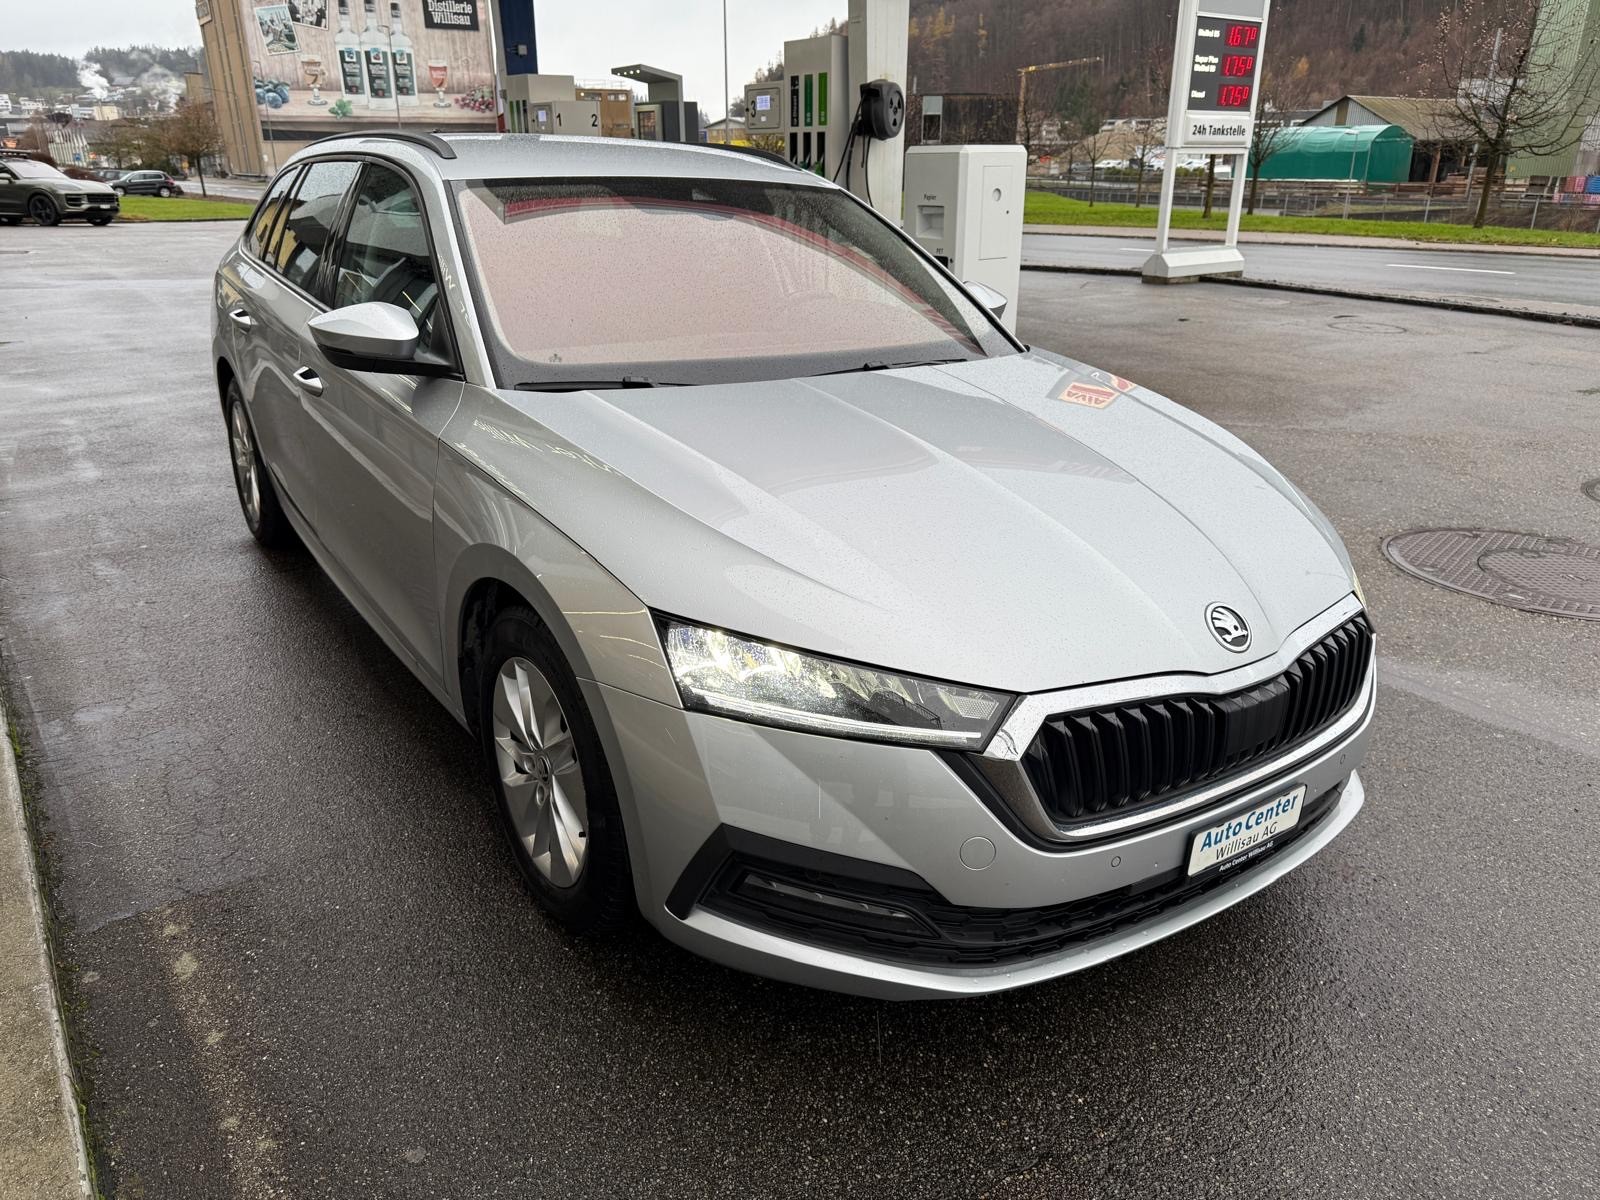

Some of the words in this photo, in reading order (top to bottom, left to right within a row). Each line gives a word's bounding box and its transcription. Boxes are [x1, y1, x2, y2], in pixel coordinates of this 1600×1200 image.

[427, 0, 473, 14] Distillerie
[431, 11, 471, 25] Willisau
[750, 100, 757, 118] 3
[556, 112, 563, 127] 1
[591, 113, 598, 127] 2
[1192, 124, 1206, 136] 24h
[1208, 124, 1246, 136] Tankstelle
[1216, 832, 1260, 861] Willisau
[1261, 821, 1279, 839] AG
[1219, 863, 1231, 872] Auto
[1231, 854, 1248, 866] Center
[1266, 840, 1274, 848] AG
